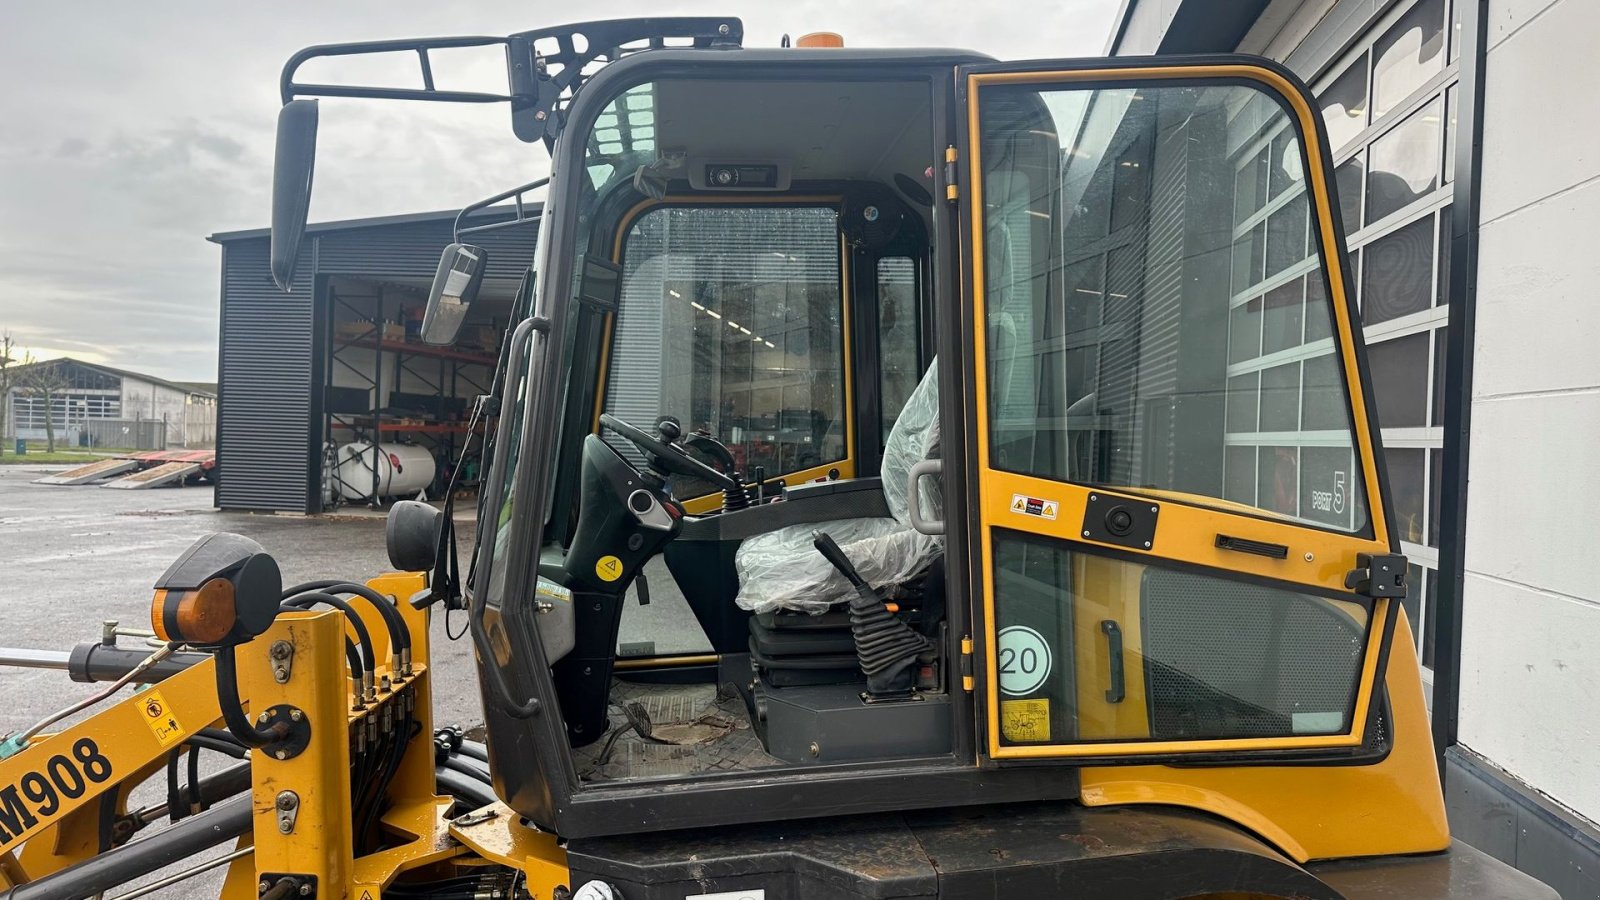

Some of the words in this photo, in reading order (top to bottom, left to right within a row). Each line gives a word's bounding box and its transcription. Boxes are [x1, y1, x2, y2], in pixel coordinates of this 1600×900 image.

[1312, 490, 1332, 511] PORT
[1333, 471, 1345, 514] 5
[999, 647, 1037, 674] 20
